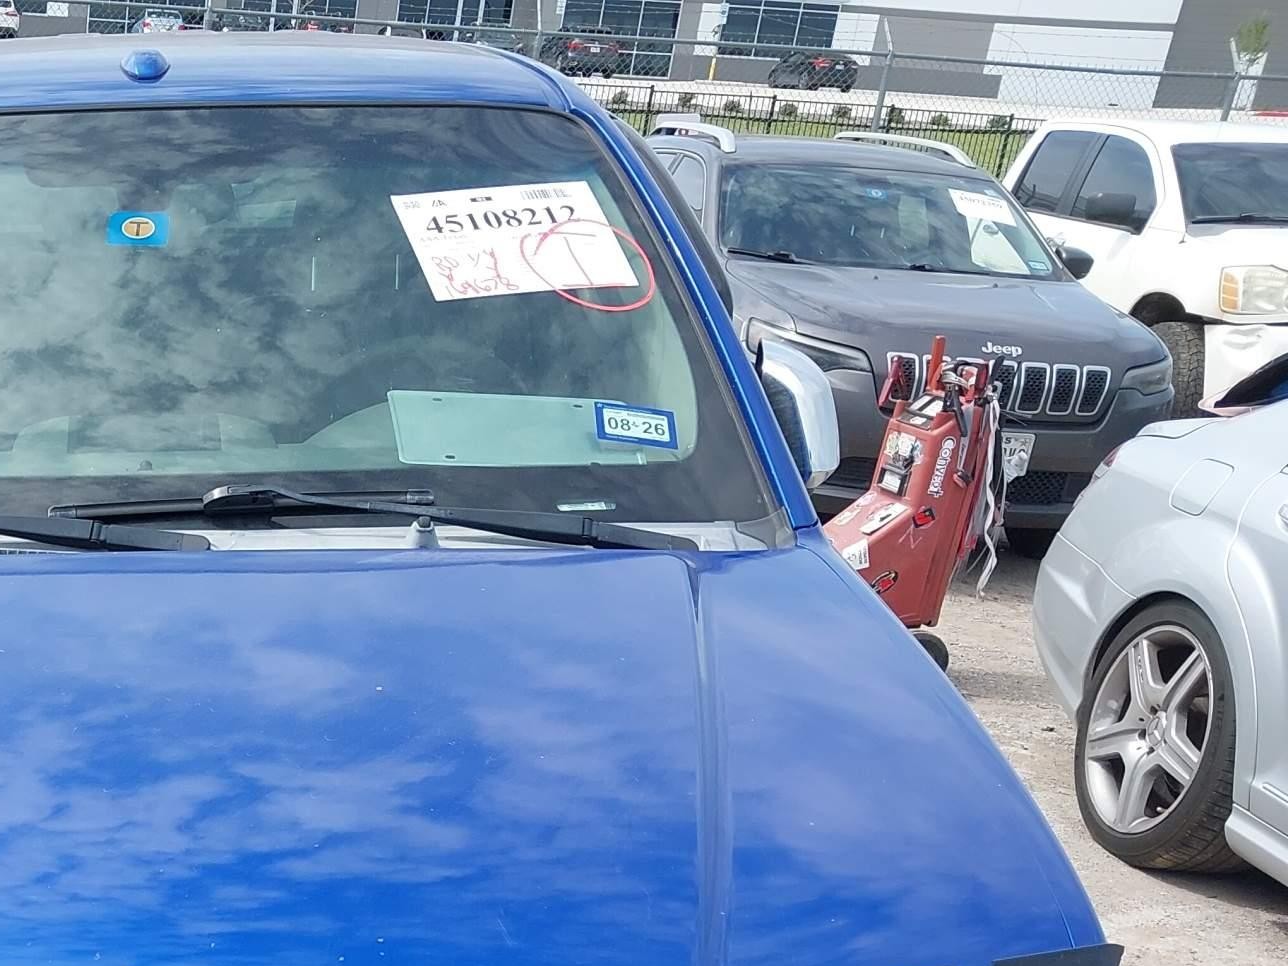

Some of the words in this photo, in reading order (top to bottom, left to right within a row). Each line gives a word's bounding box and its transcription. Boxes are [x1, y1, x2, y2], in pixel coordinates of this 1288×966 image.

[426, 205, 576, 234] 45108212
[129, 221, 149, 236] T
[981, 342, 1023, 357] Jeep
